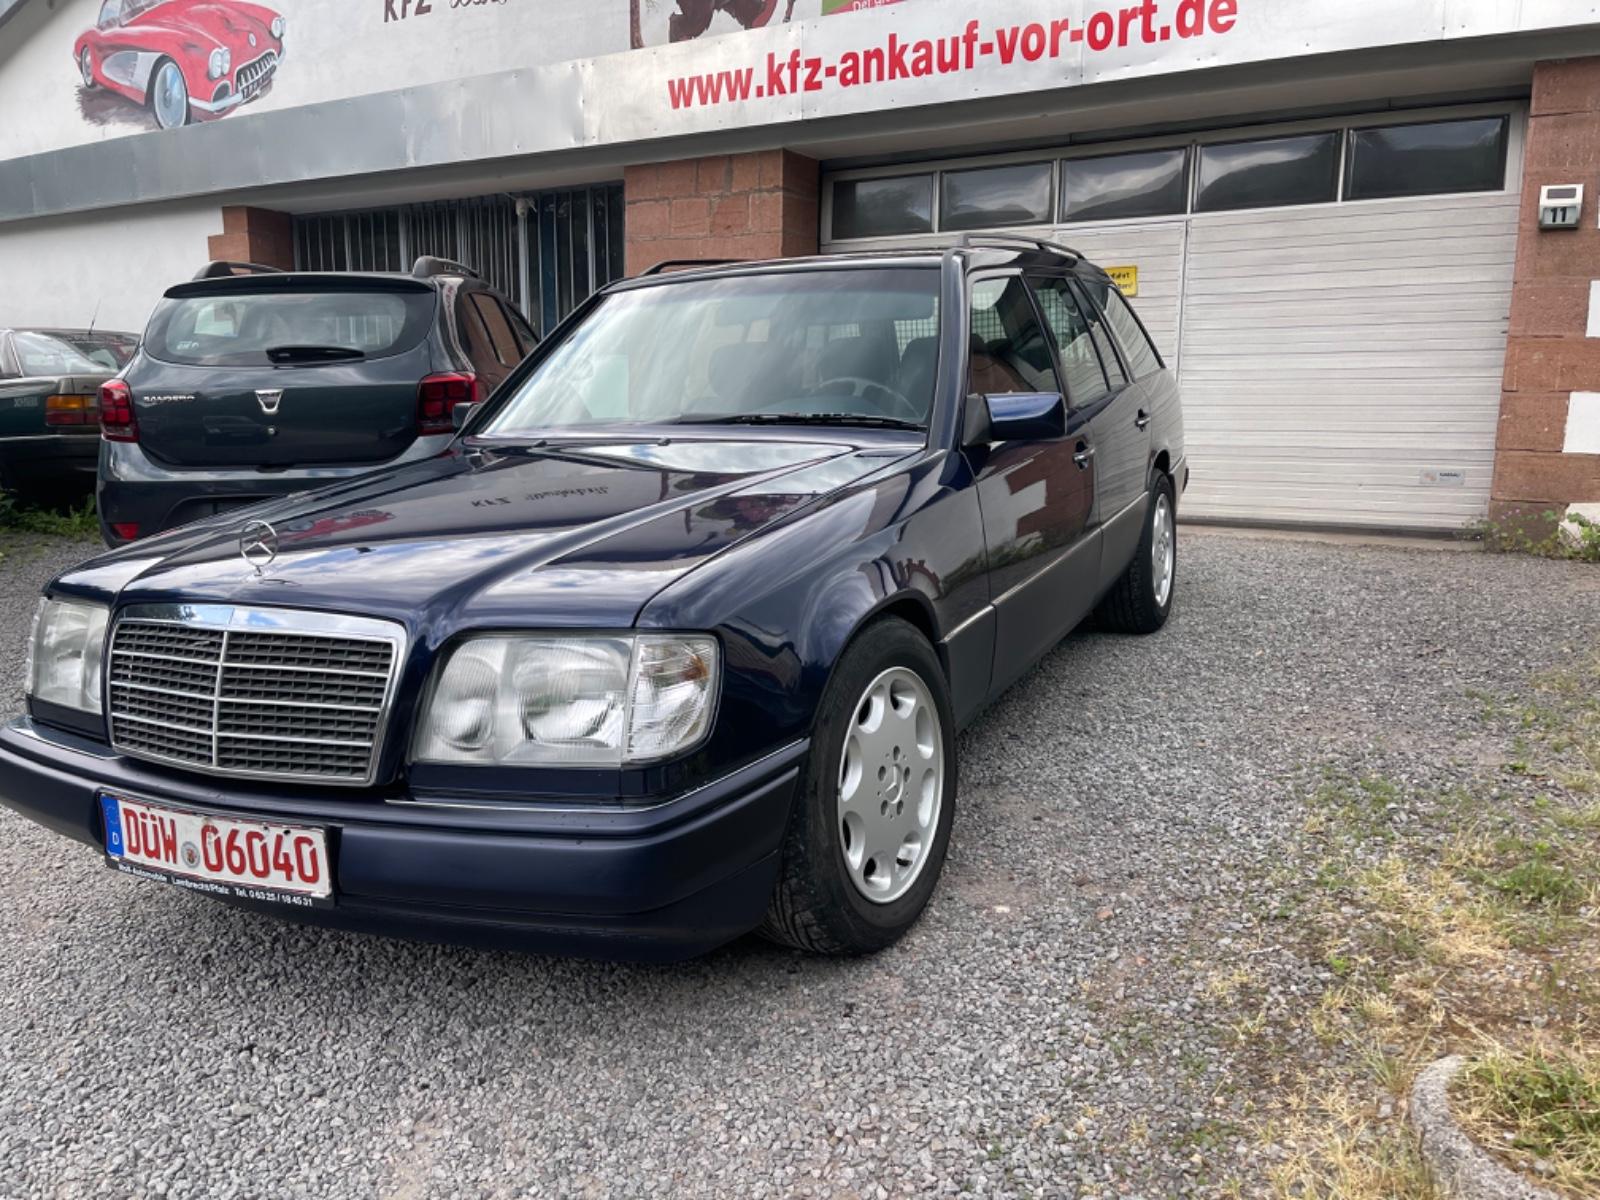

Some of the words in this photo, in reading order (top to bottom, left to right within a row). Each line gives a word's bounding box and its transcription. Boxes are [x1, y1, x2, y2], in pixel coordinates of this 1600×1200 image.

[668, 0, 1237, 109] www.kfz-ankauf-vor-ort.de
[1550, 207, 1567, 223] 11
[123, 807, 178, 864] DÜW
[201, 823, 320, 884] 06040
